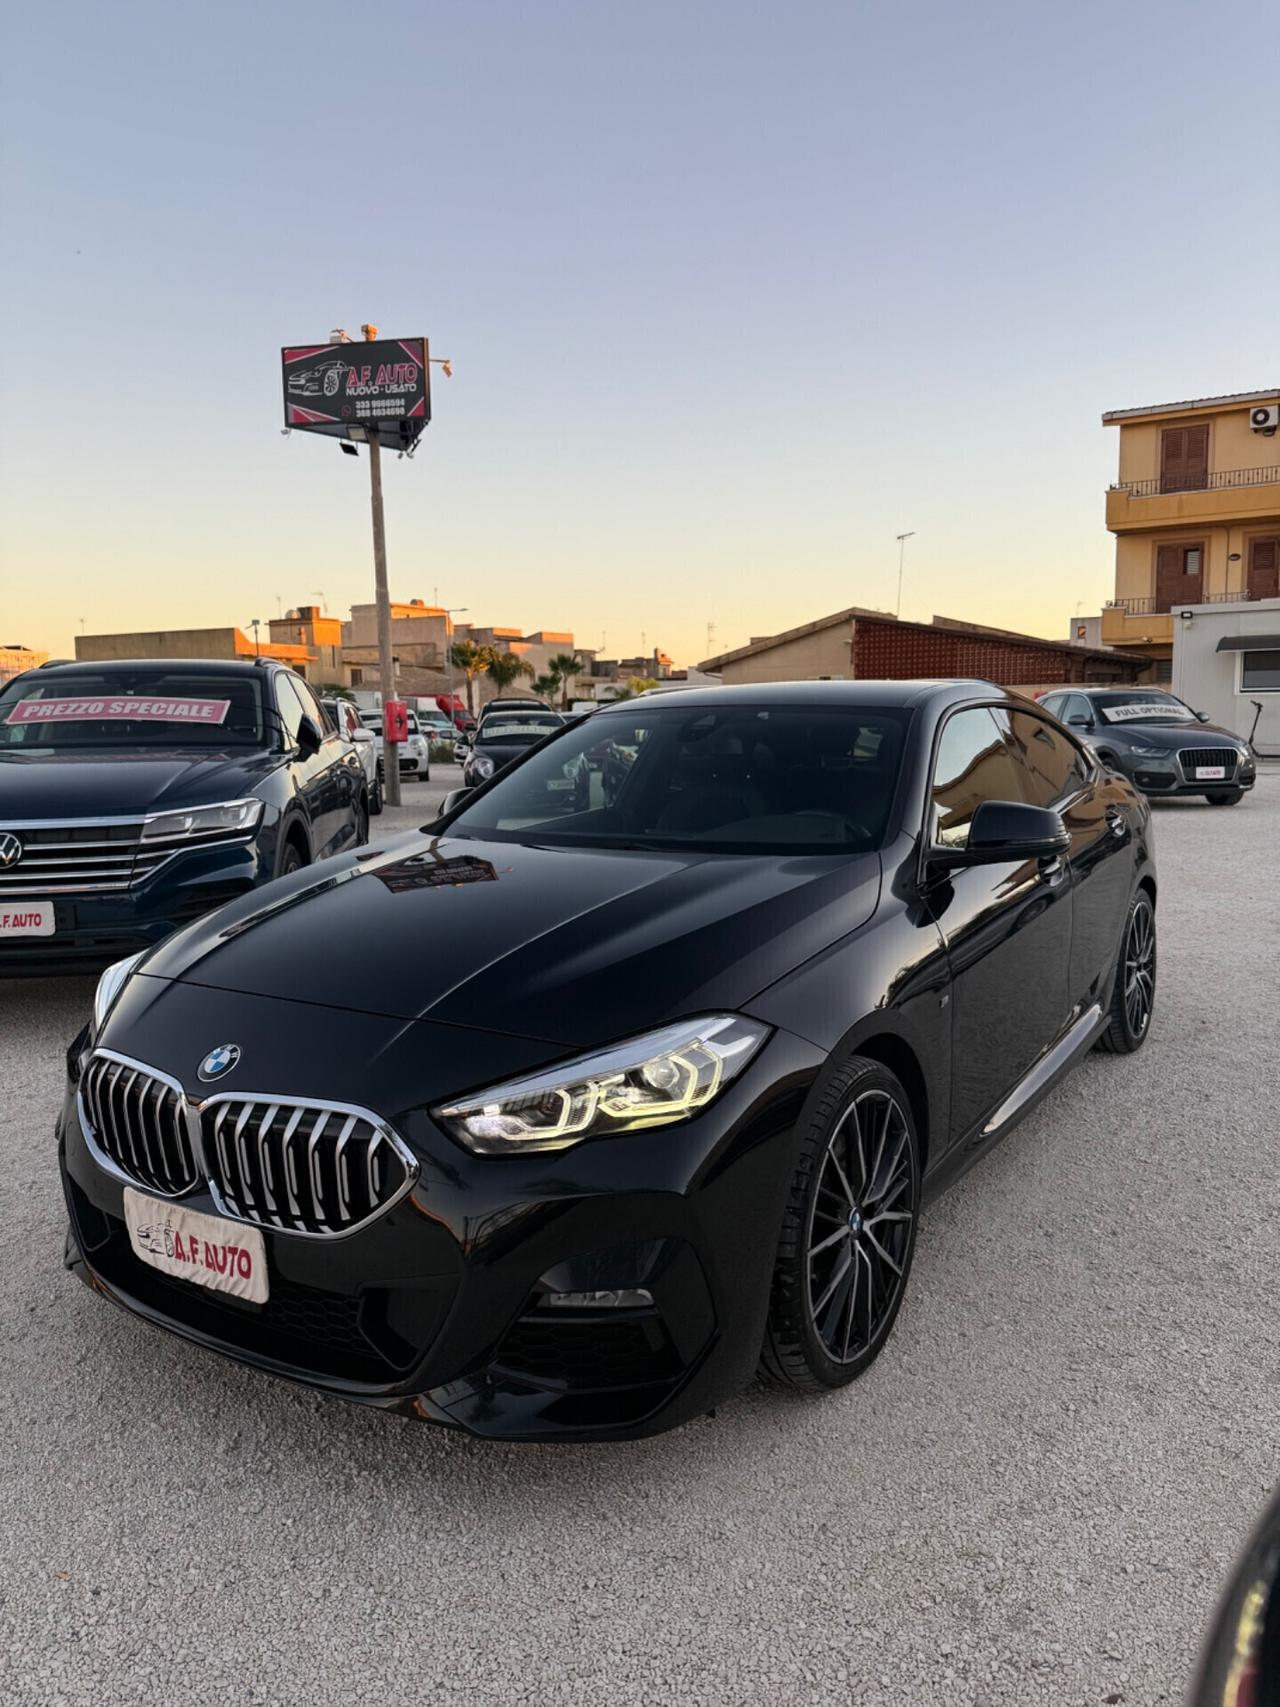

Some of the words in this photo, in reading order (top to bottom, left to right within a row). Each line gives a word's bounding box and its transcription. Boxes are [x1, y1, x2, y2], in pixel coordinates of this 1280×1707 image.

[375, 362, 418, 386] AUTO
[346, 385, 379, 396] NUOVO
[385, 383, 417, 394] USATO
[22, 702, 103, 718] PREZZO
[108, 701, 215, 717] SPECIALE
[1114, 708, 1140, 717] FULL
[1139, 706, 1185, 716] OPTIONAL
